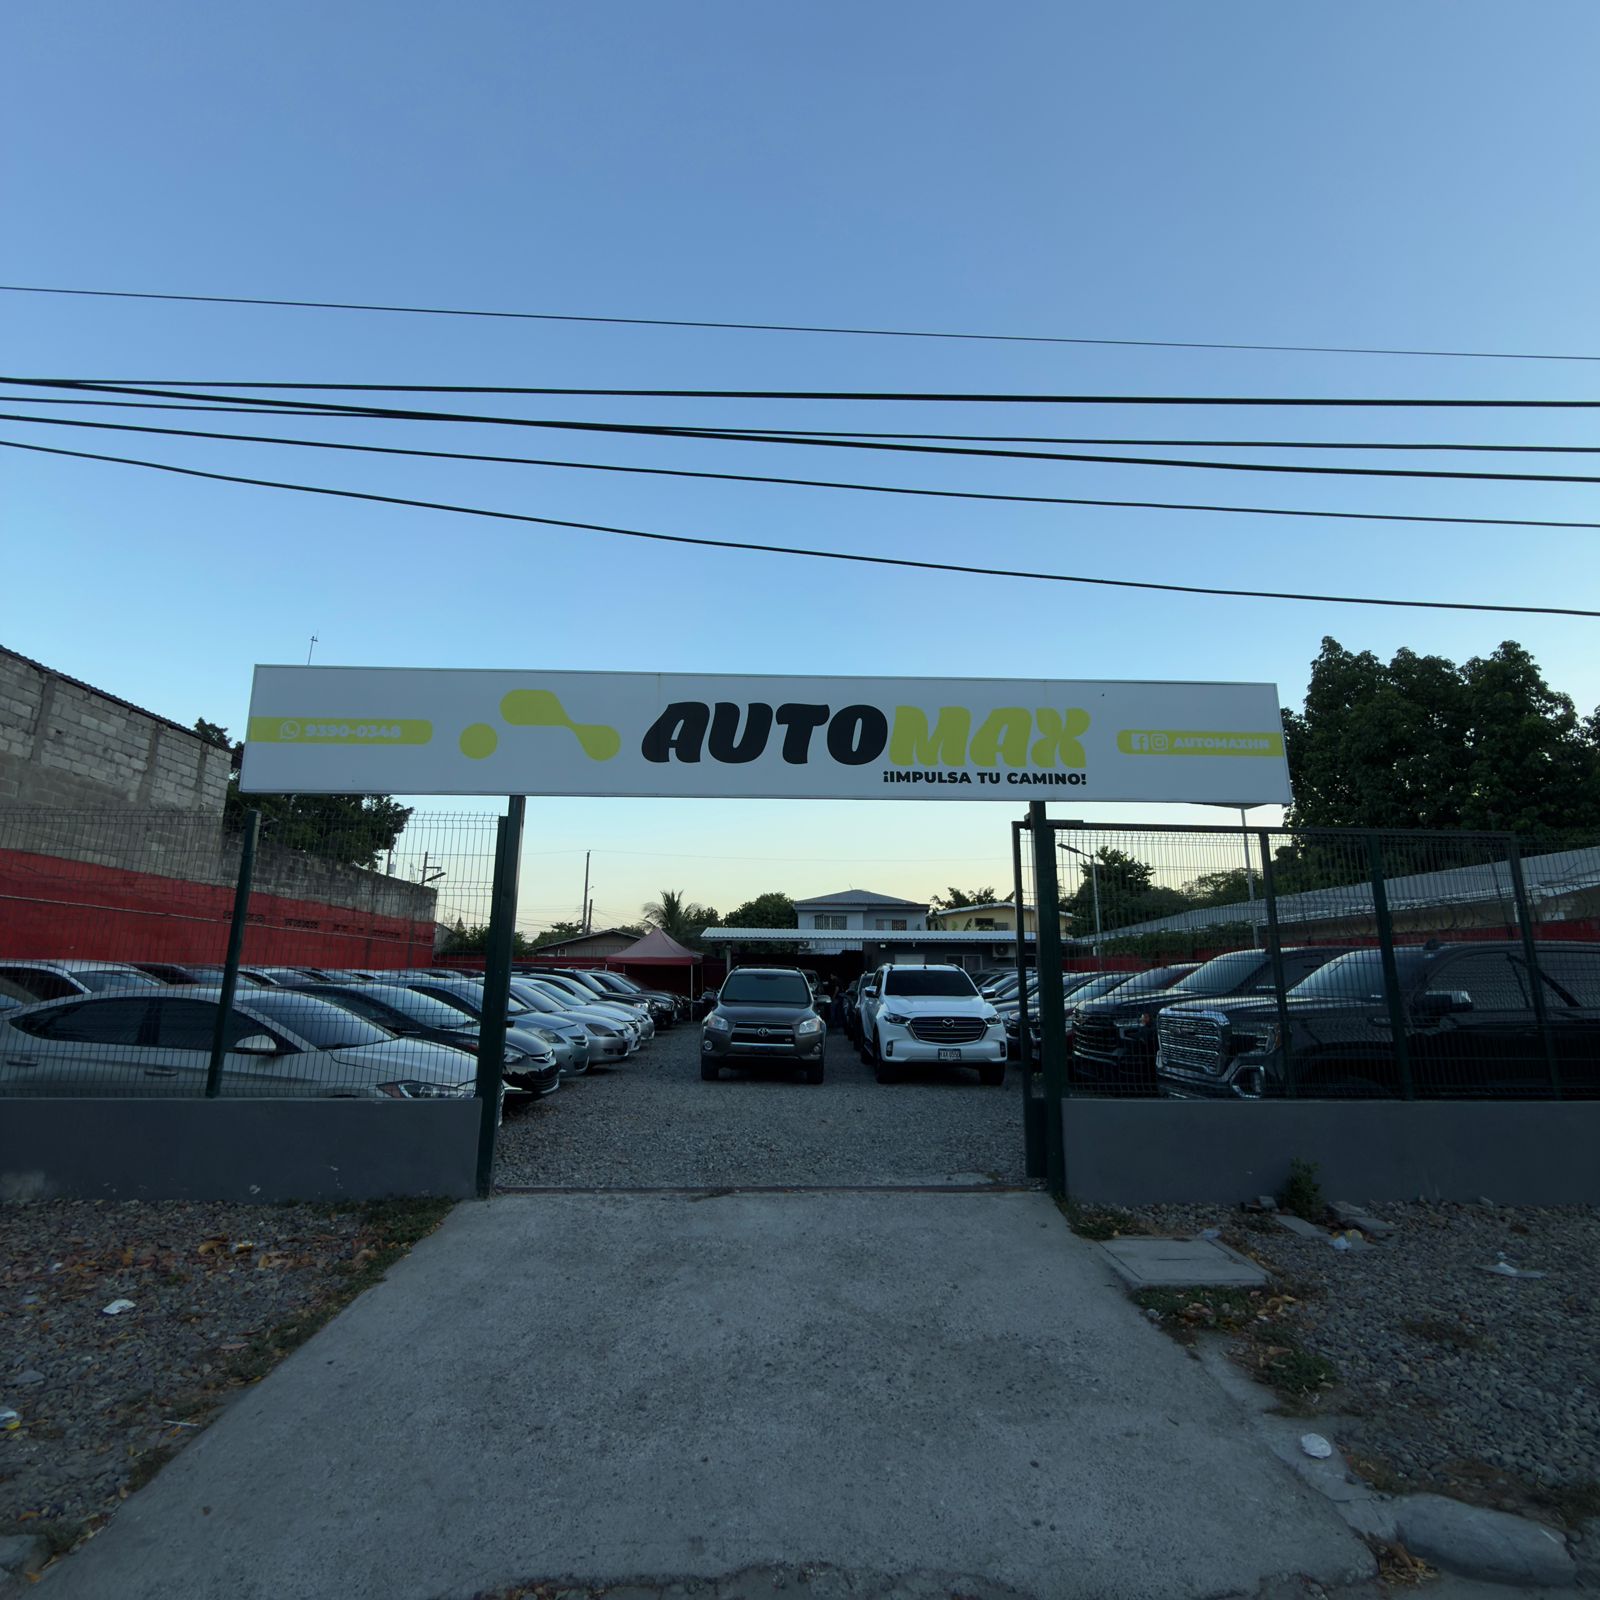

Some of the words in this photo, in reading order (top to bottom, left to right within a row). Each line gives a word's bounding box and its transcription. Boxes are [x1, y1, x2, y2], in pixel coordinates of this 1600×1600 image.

[641, 702, 1091, 768] AUTOMAX
[883, 771, 972, 784] ¡IMPULSA
[977, 772, 1000, 784] TU
[1007, 773, 1087, 785] CAMINO!
